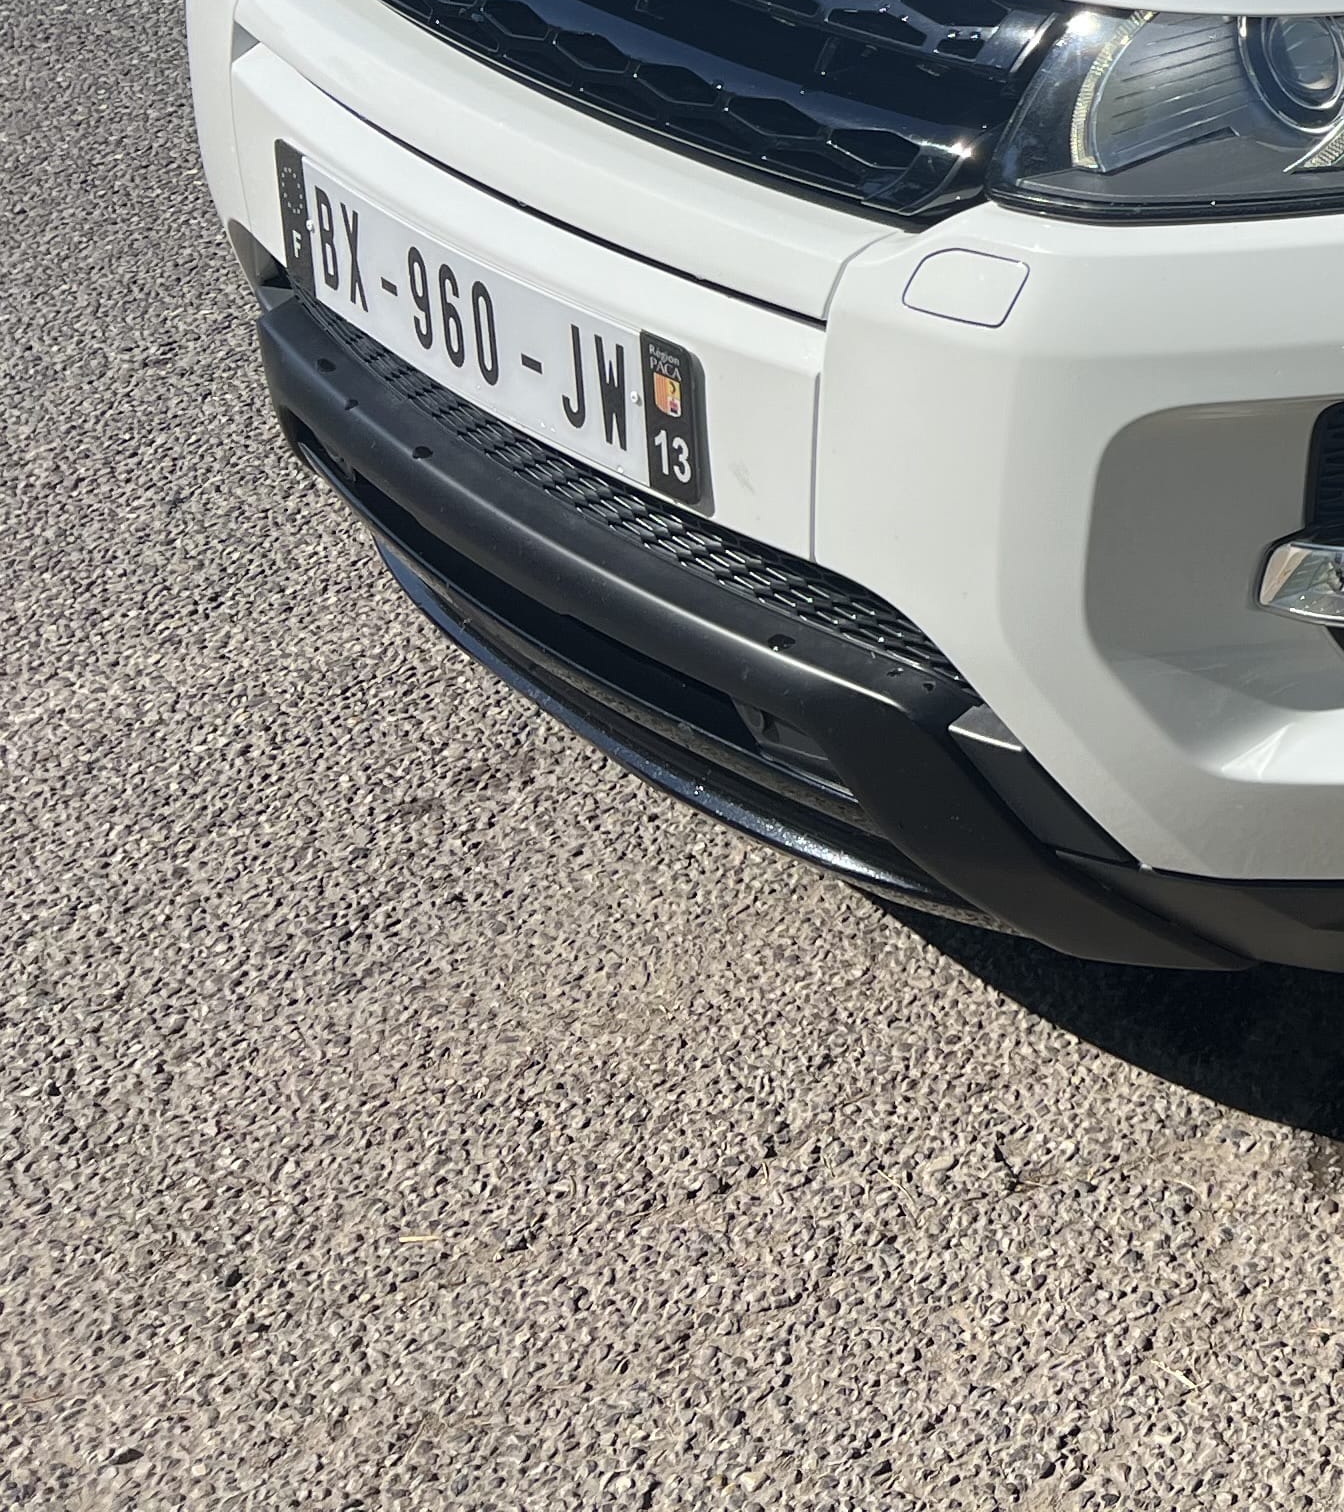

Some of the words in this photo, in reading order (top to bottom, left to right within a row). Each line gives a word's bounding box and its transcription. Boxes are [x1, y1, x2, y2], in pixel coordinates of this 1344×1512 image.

[292, 229, 302, 259] F
[315, 185, 627, 451] BX-960-JW
[648, 343, 681, 366] Région
[650, 356, 682, 381] PACA
[654, 429, 692, 484] 13
